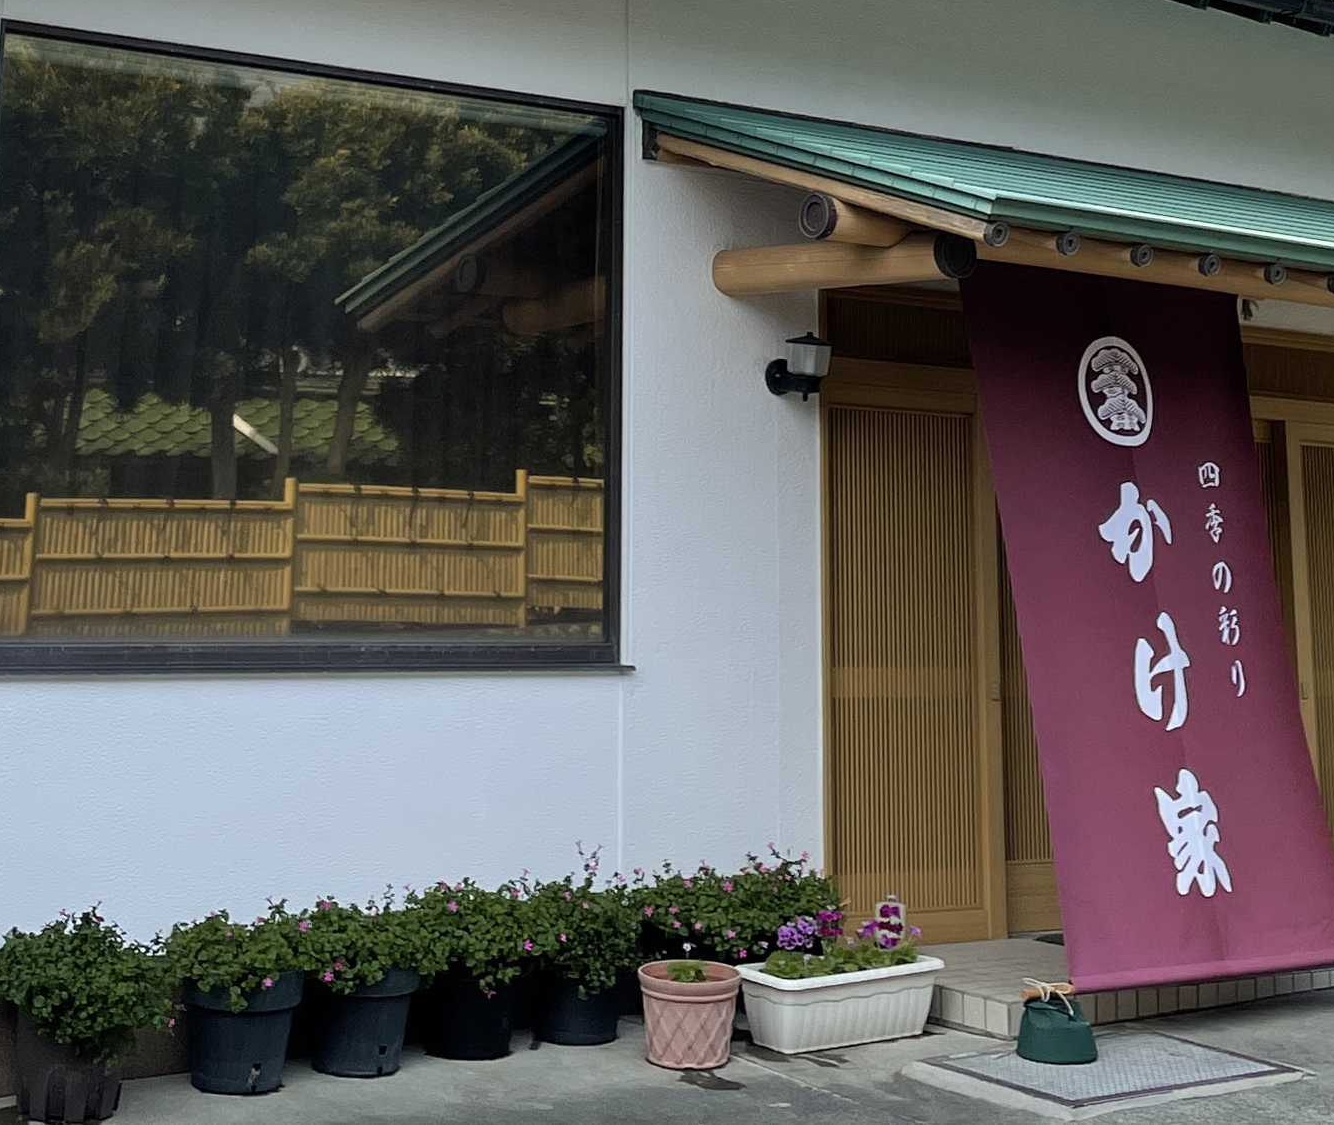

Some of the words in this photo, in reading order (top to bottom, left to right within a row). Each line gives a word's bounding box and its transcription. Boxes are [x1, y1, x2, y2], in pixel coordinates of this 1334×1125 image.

[1098, 481, 1234, 899] かけ家
[1198, 461, 1246, 698] 四季の彩り
